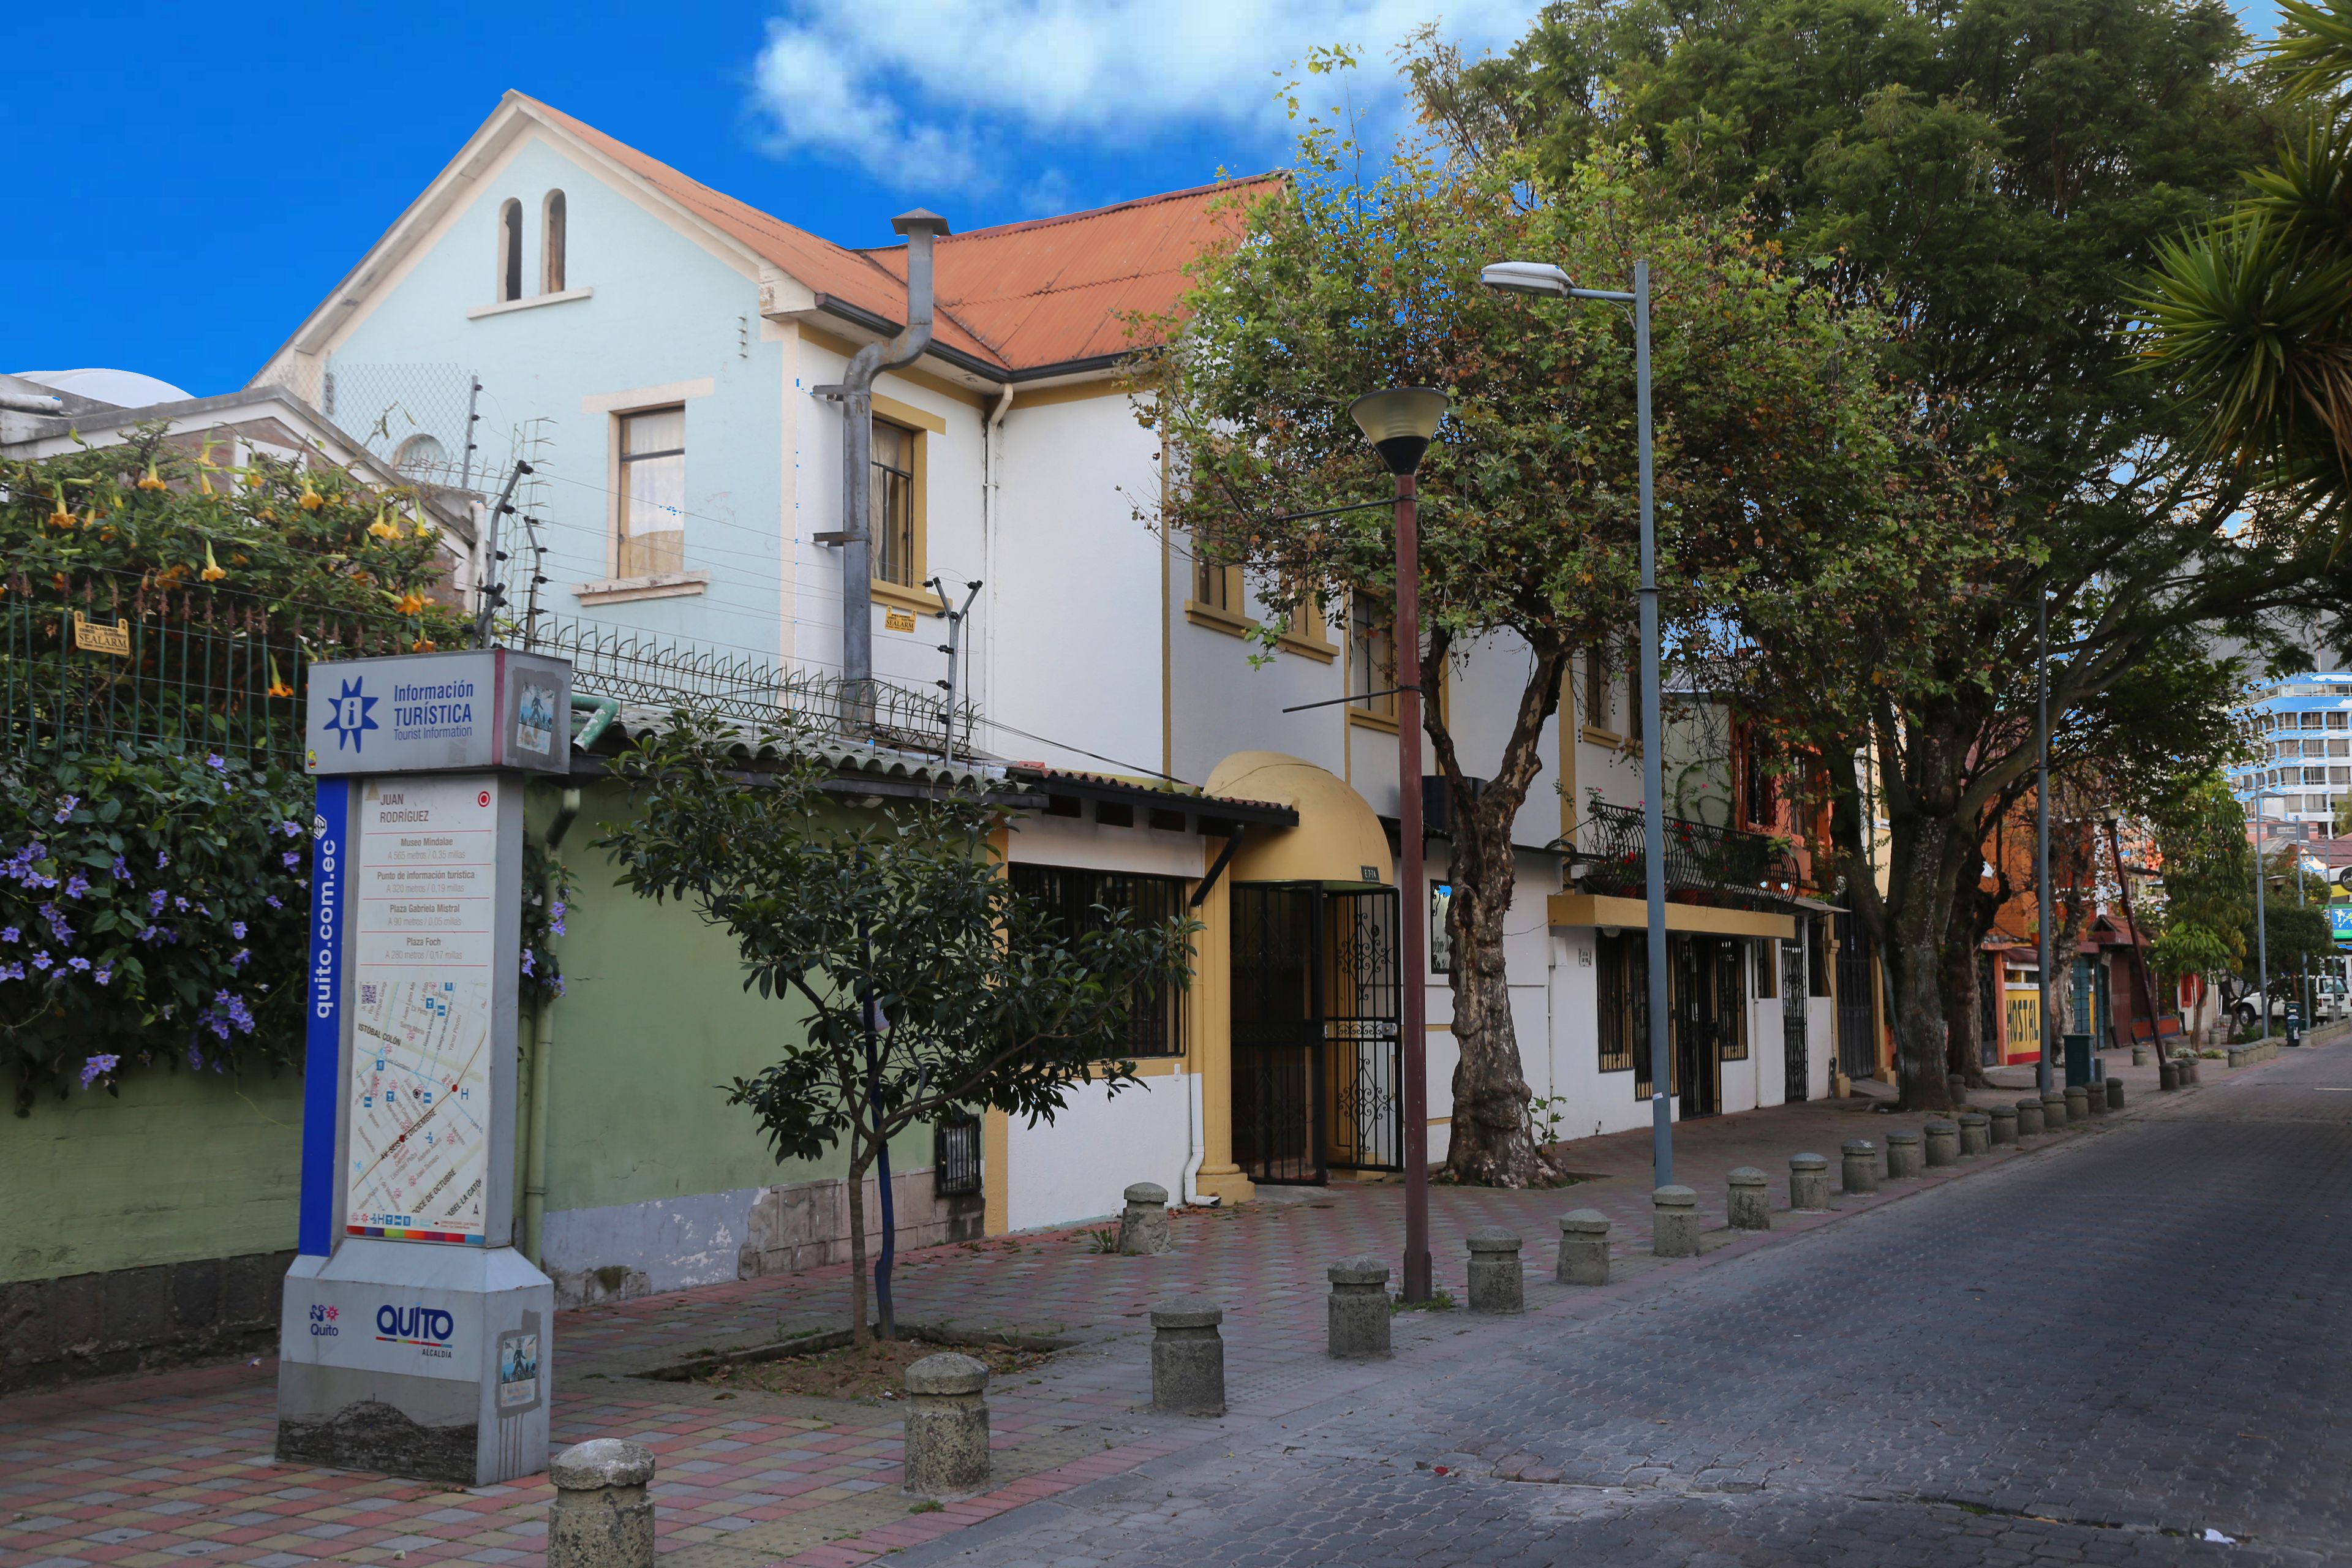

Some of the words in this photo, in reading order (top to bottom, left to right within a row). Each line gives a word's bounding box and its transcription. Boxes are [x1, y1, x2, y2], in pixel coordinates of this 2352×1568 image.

[85, 624, 118, 633] PELIGRO
[886, 620, 914, 628] SEALARM
[78, 633, 127, 648] SEALARM
[394, 680, 473, 702] Información
[394, 701, 472, 726] TURÍSTICA
[394, 728, 421, 741] Tourist
[423, 725, 472, 739] Information
[380, 793, 404, 805] JUAN
[380, 809, 429, 823] RODRÍGUEZ
[423, 837, 453, 846] Mindalae
[407, 851, 427, 859] metros
[448, 850, 466, 859] millas
[377, 871, 396, 880] Punto
[397, 871, 405, 880] de
[407, 870, 446, 880] información
[405, 884, 426, 892] metros
[447, 883, 464, 892] millas
[390, 904, 407, 913] Plaza
[409, 903, 435, 913] Gabriela
[437, 903, 460, 913] Mistral
[388, 918, 393, 926] A
[394, 917, 402, 926] 90
[403, 917, 423, 926] metros
[444, 916, 461, 925] millas
[314, 840, 336, 1019] quito.com.ec
[407, 937, 424, 946] Plaza
[426, 937, 441, 946] Foch
[385, 951, 390, 959] A
[391, 951, 403, 959] 280
[404, 951, 424, 960] metros
[445, 951, 462, 960] millas
[453, 1014, 462, 1033] Pinzón
[2006, 999, 2039, 1048] HOSTAL
[382, 1033, 402, 1047] COLÓN
[409, 1109, 437, 1137] DICIEMBRE
[425, 1191, 435, 1203] DE
[432, 1167, 457, 1196] OCTUBRE
[460, 1194, 470, 1205] LA
[377, 1300, 454, 1341] QUITO
[310, 1323, 339, 1336] Quito
[422, 1348, 452, 1359] ALCALDÍA
